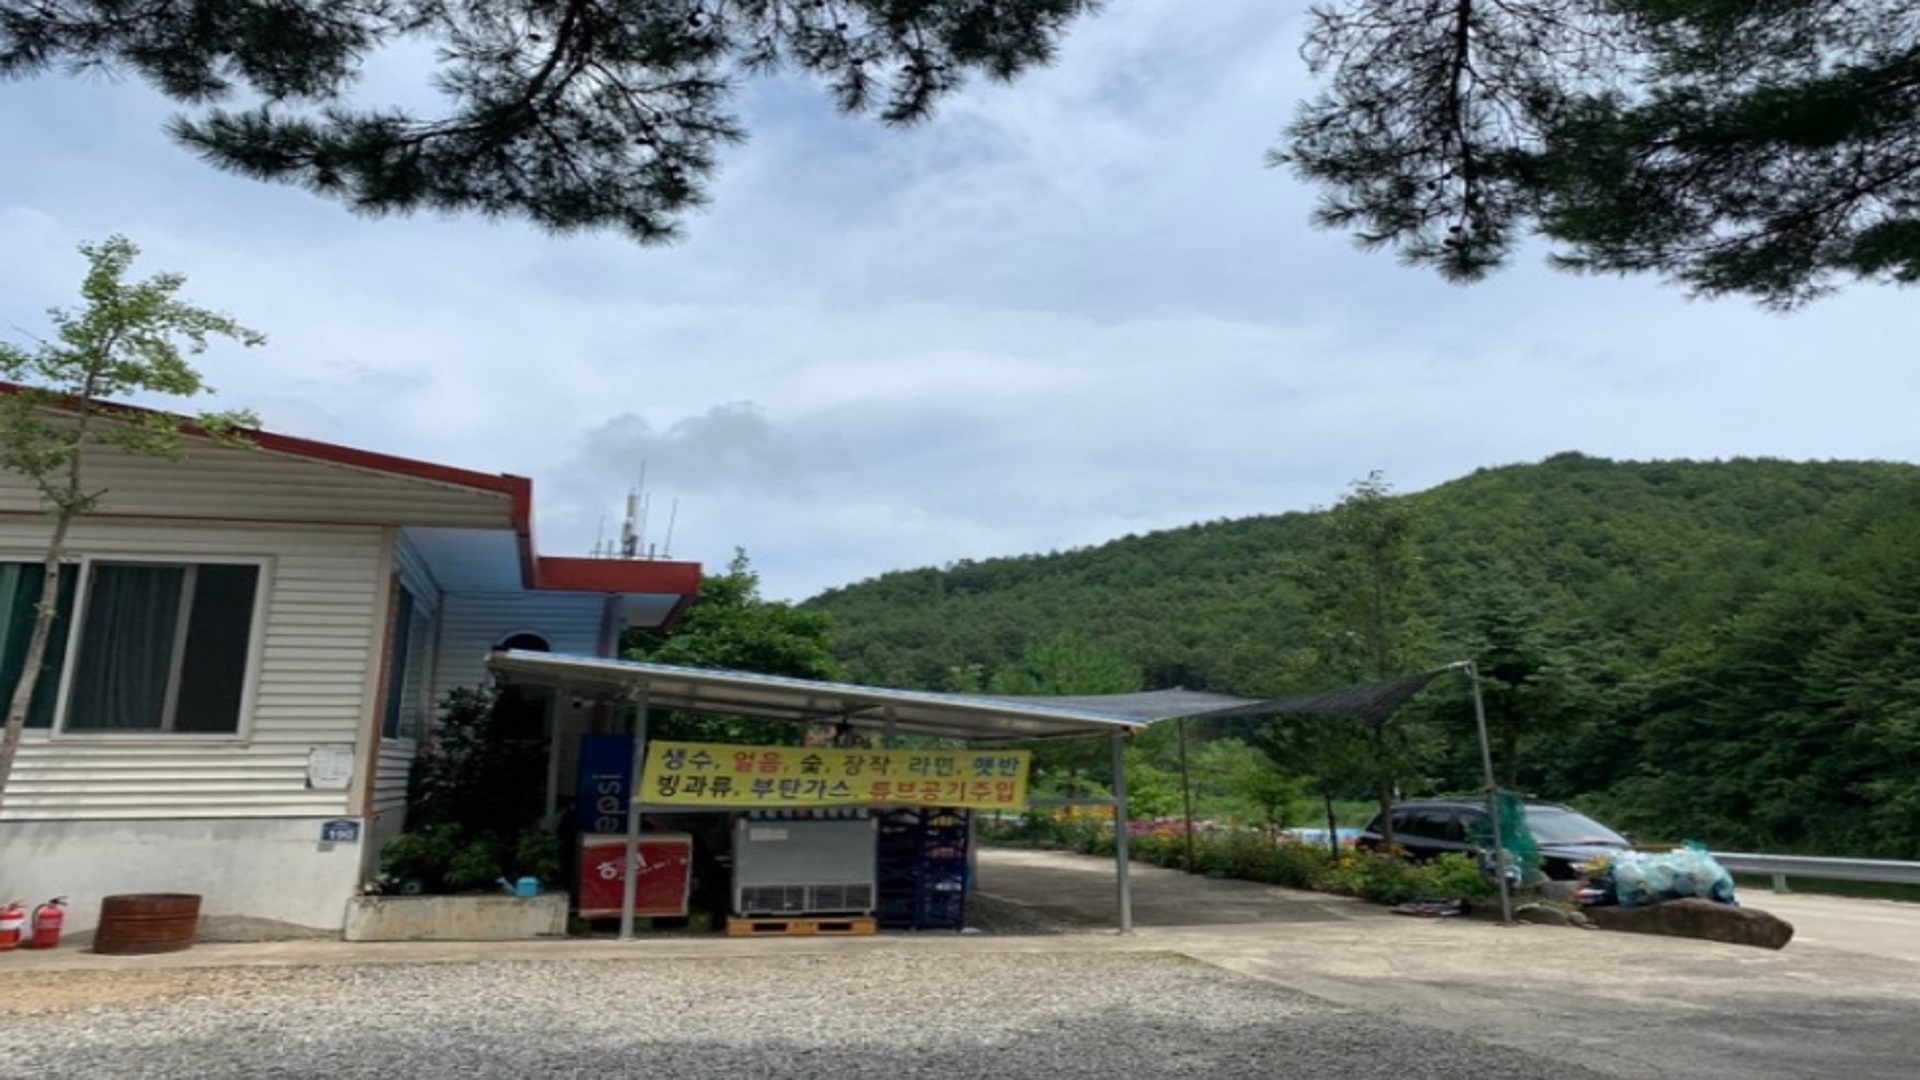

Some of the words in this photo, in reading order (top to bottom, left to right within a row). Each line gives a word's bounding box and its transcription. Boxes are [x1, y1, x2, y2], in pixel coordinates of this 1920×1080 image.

[662, 748, 720, 771] 생수,
[732, 751, 789, 773] 얼음,
[800, 753, 831, 774] 숯,
[843, 754, 898, 776] 장작,
[908, 756, 963, 777] 라면,
[972, 756, 1020, 777] 햇반
[591, 774, 626, 832] epsi
[657, 774, 740, 797] 빙과류,
[751, 778, 859, 800] 부탄가스,
[869, 780, 1016, 803] 튜브공기주입
